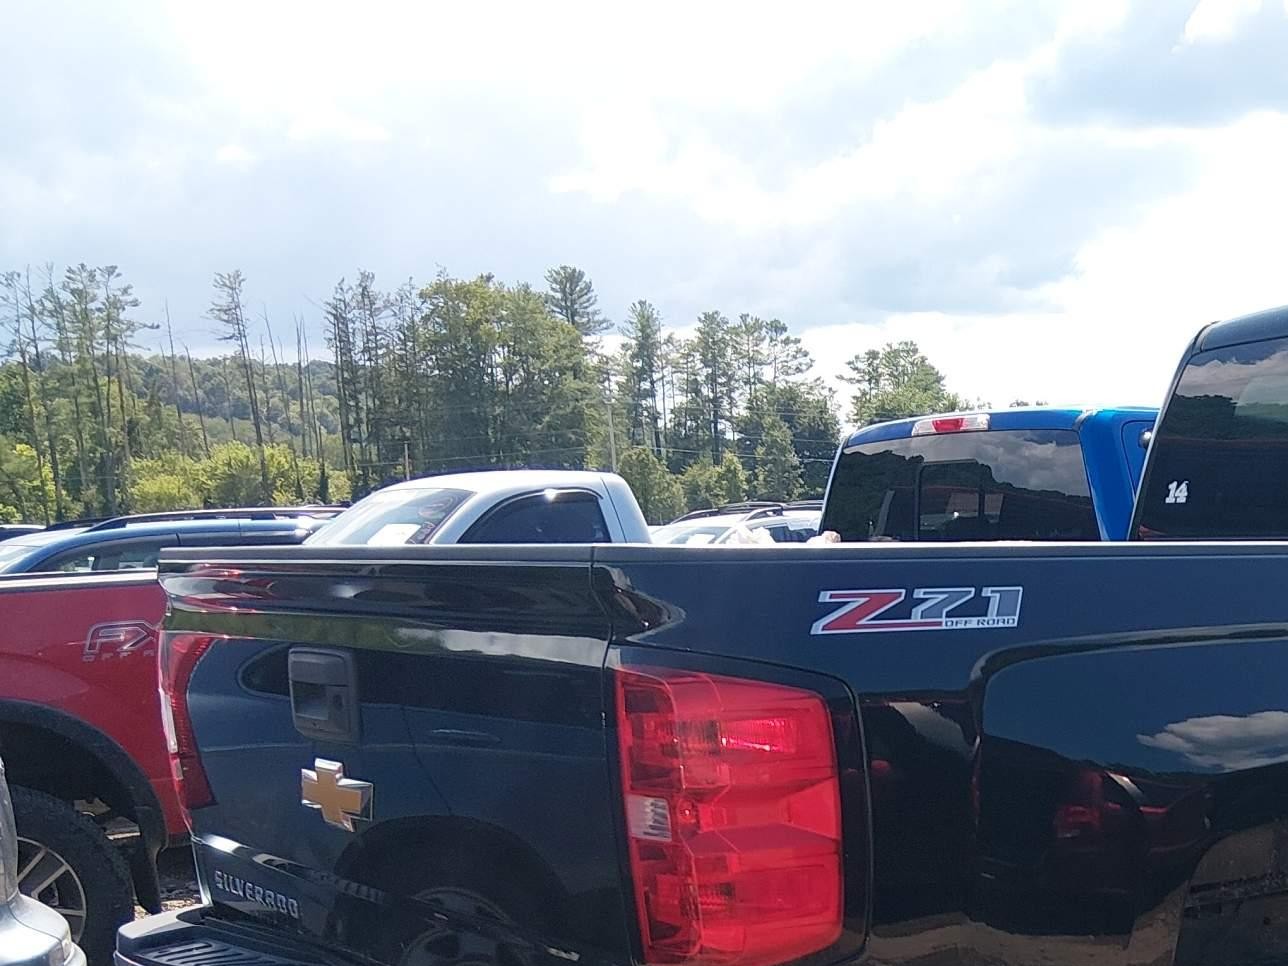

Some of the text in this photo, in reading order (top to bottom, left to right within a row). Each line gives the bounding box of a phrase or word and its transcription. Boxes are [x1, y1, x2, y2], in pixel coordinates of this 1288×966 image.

[1164, 480, 1189, 504] 14
[810, 586, 1023, 635] Z71
[945, 617, 1017, 628] OFF ROAD
[214, 870, 300, 920] SILVERADO
